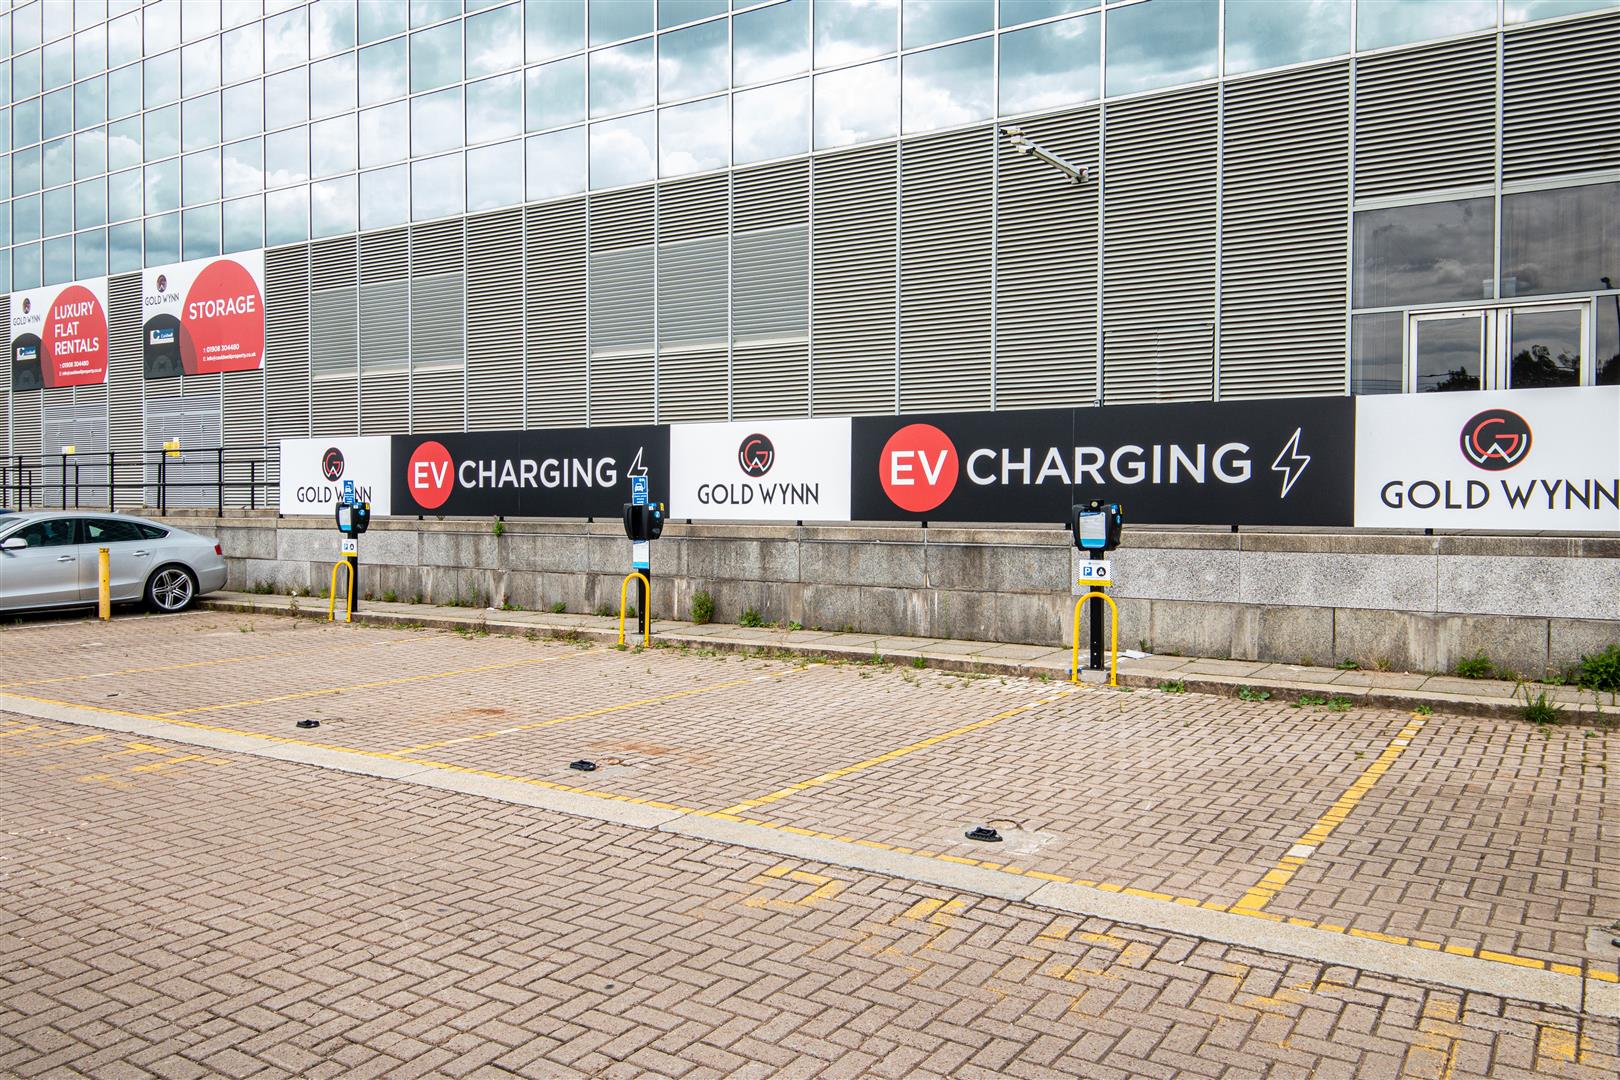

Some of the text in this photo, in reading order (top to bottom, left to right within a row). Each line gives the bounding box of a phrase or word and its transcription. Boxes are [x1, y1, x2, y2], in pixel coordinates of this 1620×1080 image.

[145, 293, 180, 306] GOLD WYNN
[189, 294, 256, 320] STORAGE
[54, 300, 95, 320] LUXURY
[13, 316, 26, 326] GOLD
[54, 321, 80, 338] FLAT
[54, 337, 100, 356] RENTALS
[414, 456, 618, 489] EV CHARGING
[891, 442, 1252, 486] EV CHARGING
[296, 485, 372, 503] GOLD WNN
[697, 483, 819, 505] GOLD WYNN
[1380, 478, 1620, 510] GOLD WYNN
